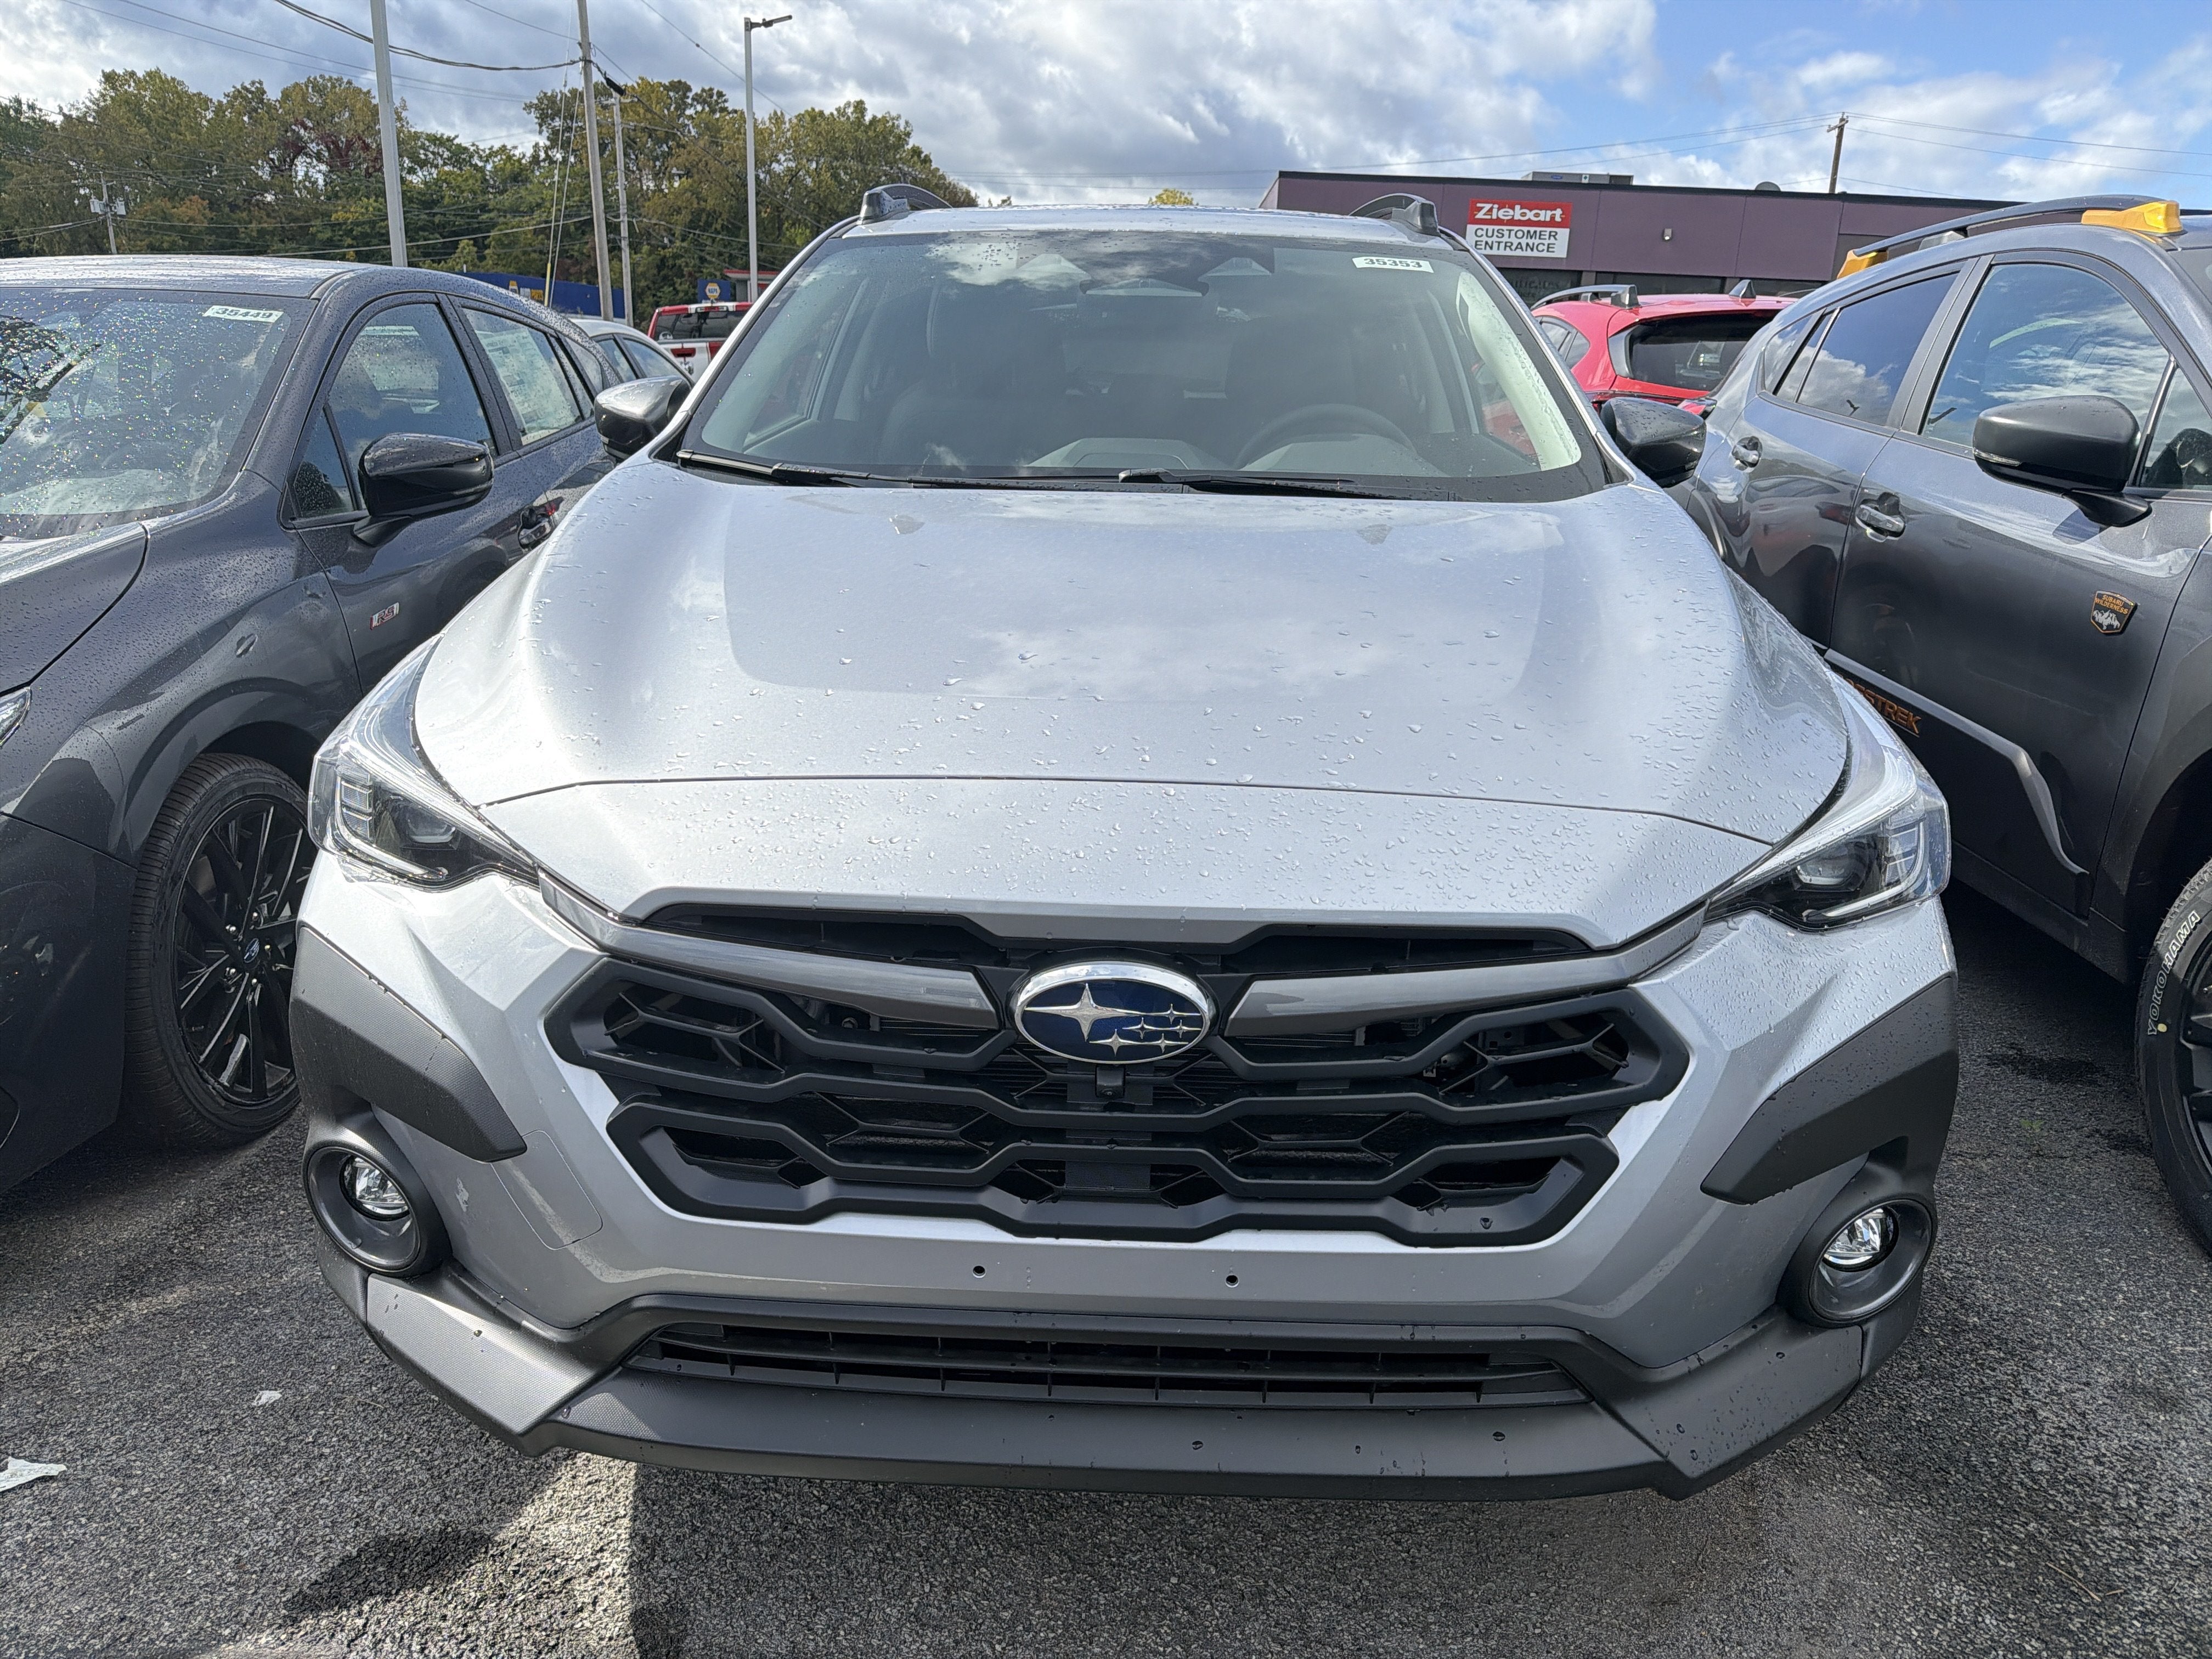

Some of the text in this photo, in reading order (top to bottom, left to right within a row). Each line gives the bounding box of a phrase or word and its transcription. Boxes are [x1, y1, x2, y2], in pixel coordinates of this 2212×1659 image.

[1475, 203, 1562, 222] Ziebart
[1474, 228, 1558, 241] CUSTOMER
[1474, 240, 1556, 253] ENTRANCE
[1364, 258, 1423, 268] 35353
[216, 308, 273, 319] 35449
[2095, 598, 2128, 614] WILDERNESS
[2102, 594, 2124, 606] SUBARU
[2147, 910, 2200, 1035] YOKOHAMA
